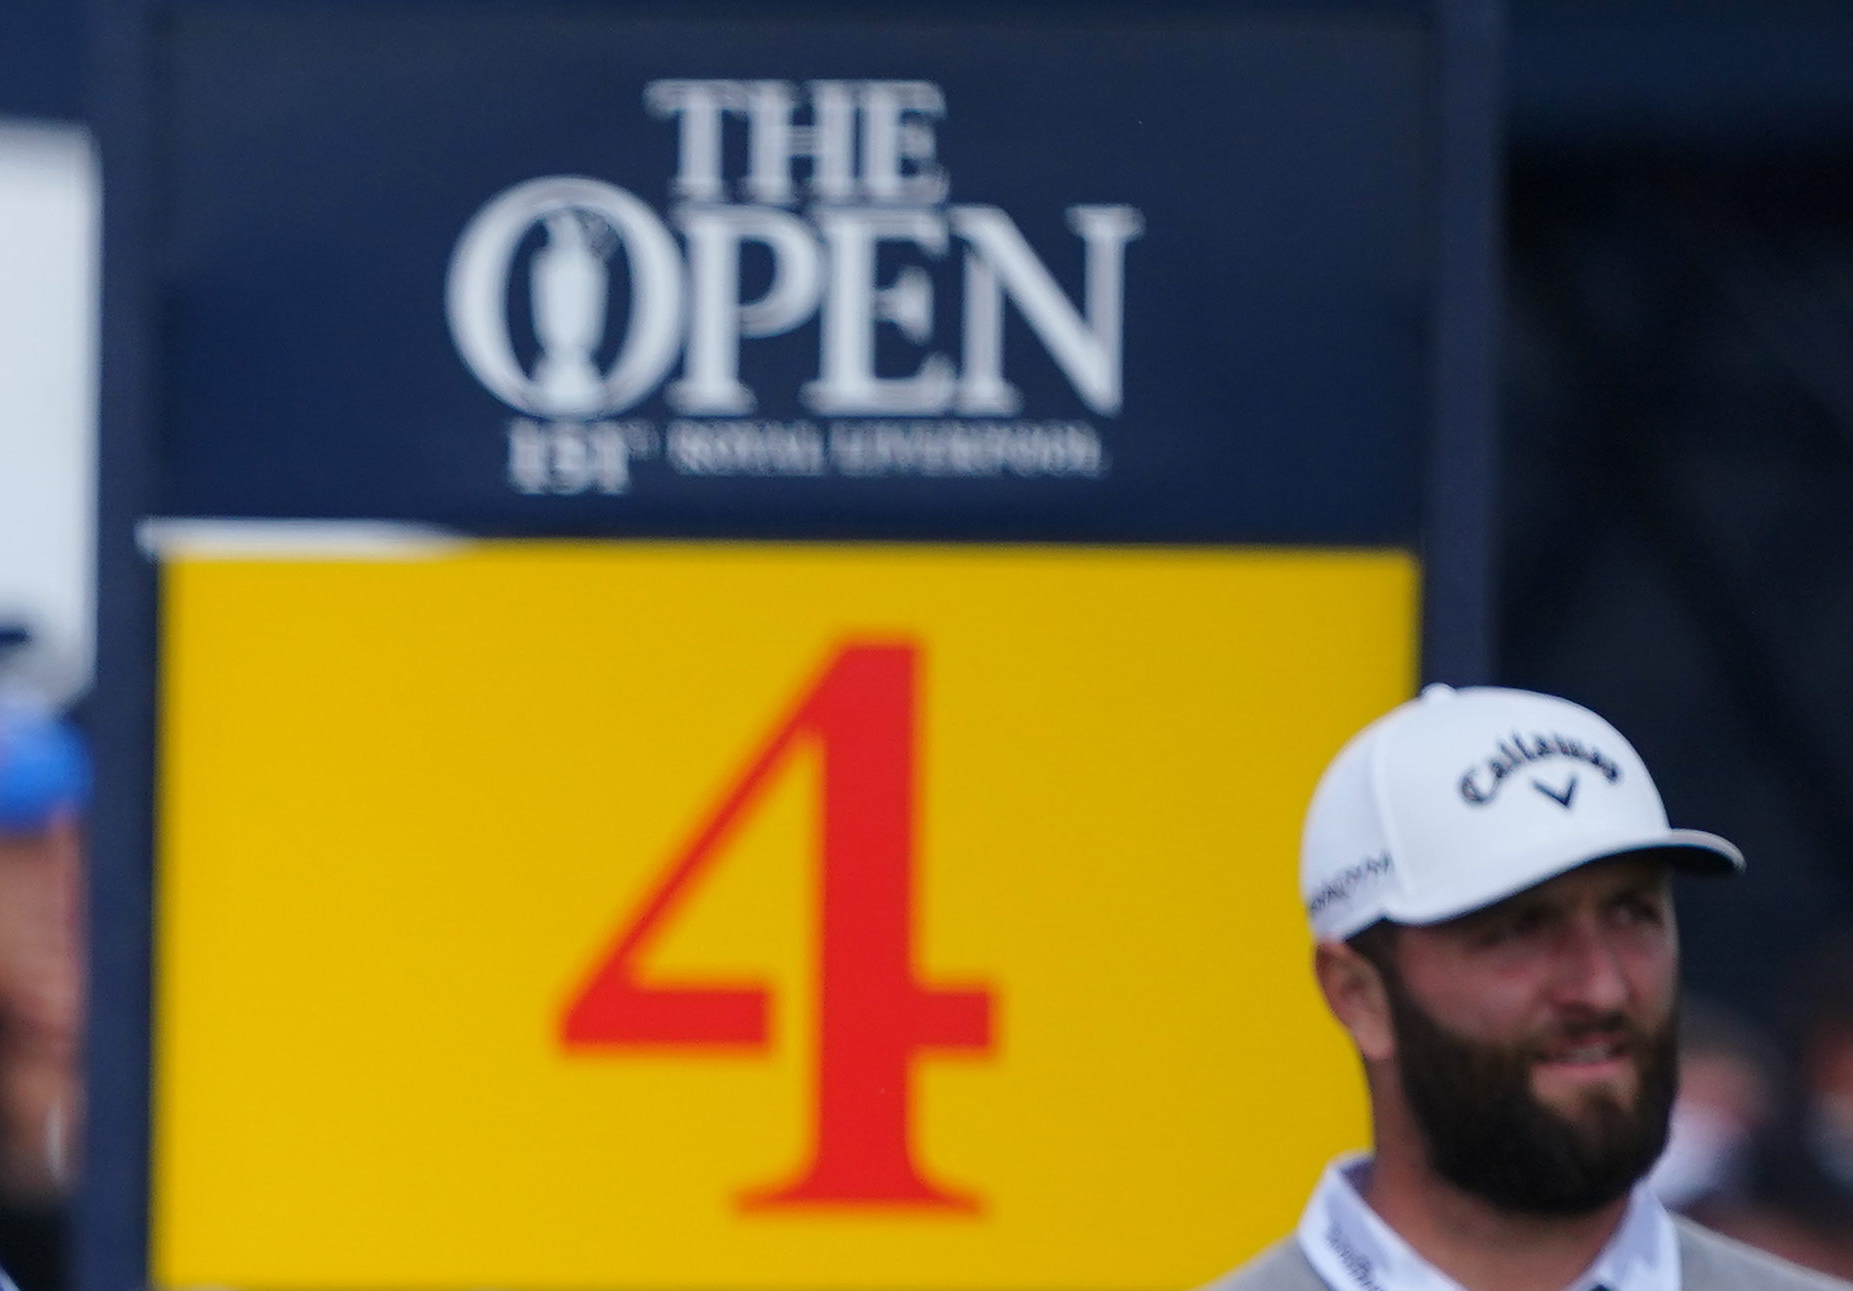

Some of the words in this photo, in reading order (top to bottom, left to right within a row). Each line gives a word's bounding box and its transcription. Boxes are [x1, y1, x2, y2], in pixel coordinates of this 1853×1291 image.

[643, 78, 949, 202] THE
[446, 176, 1146, 420] OPEN
[1456, 730, 1621, 806] Callaway
[556, 636, 1000, 1213] 4
